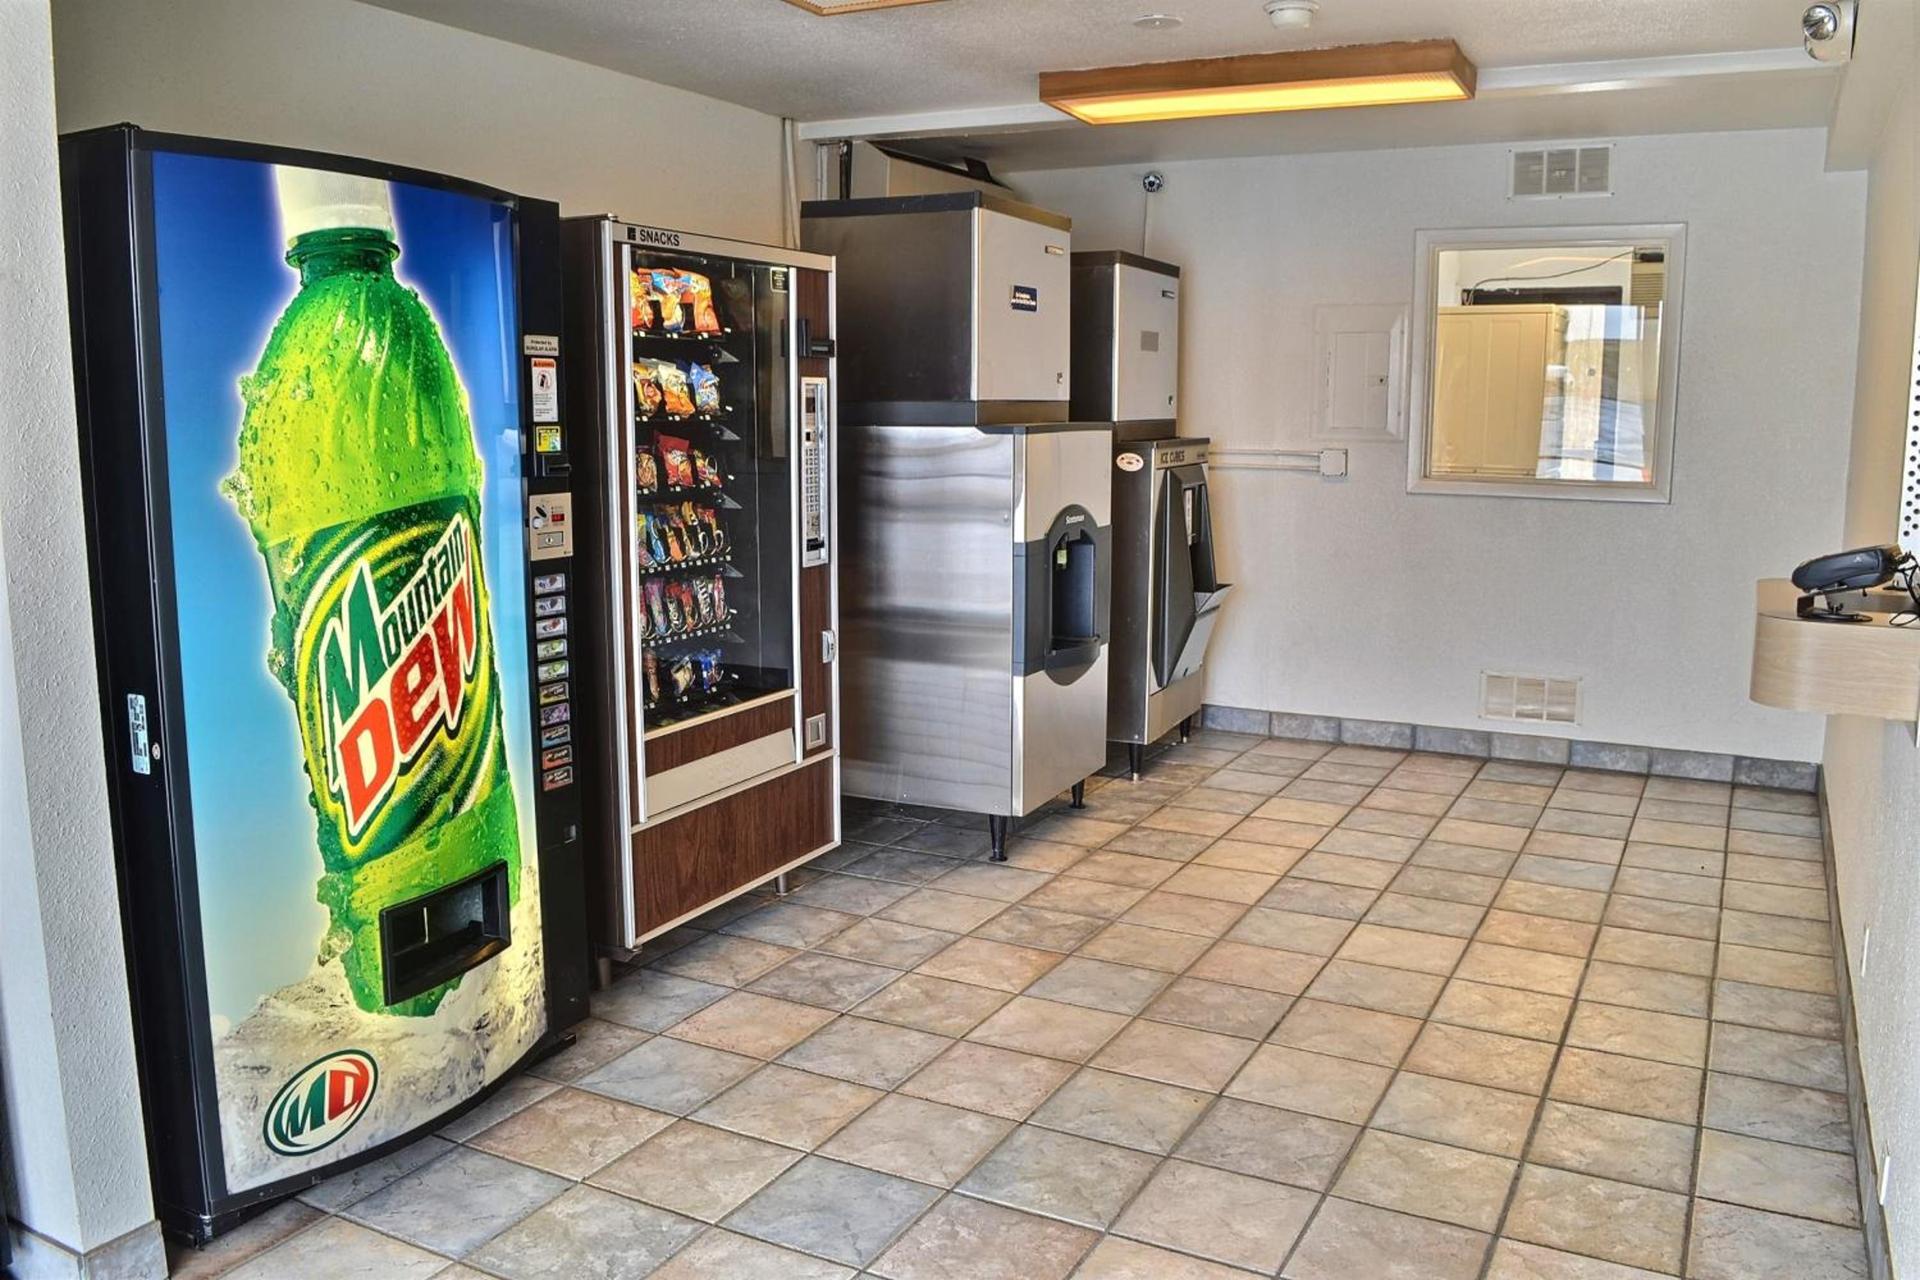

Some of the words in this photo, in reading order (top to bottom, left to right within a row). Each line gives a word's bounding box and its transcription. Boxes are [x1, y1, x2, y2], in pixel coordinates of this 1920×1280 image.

[639, 229, 680, 247] SNACKS
[1160, 451, 1169, 464] ICE
[320, 513, 467, 792] Mountain
